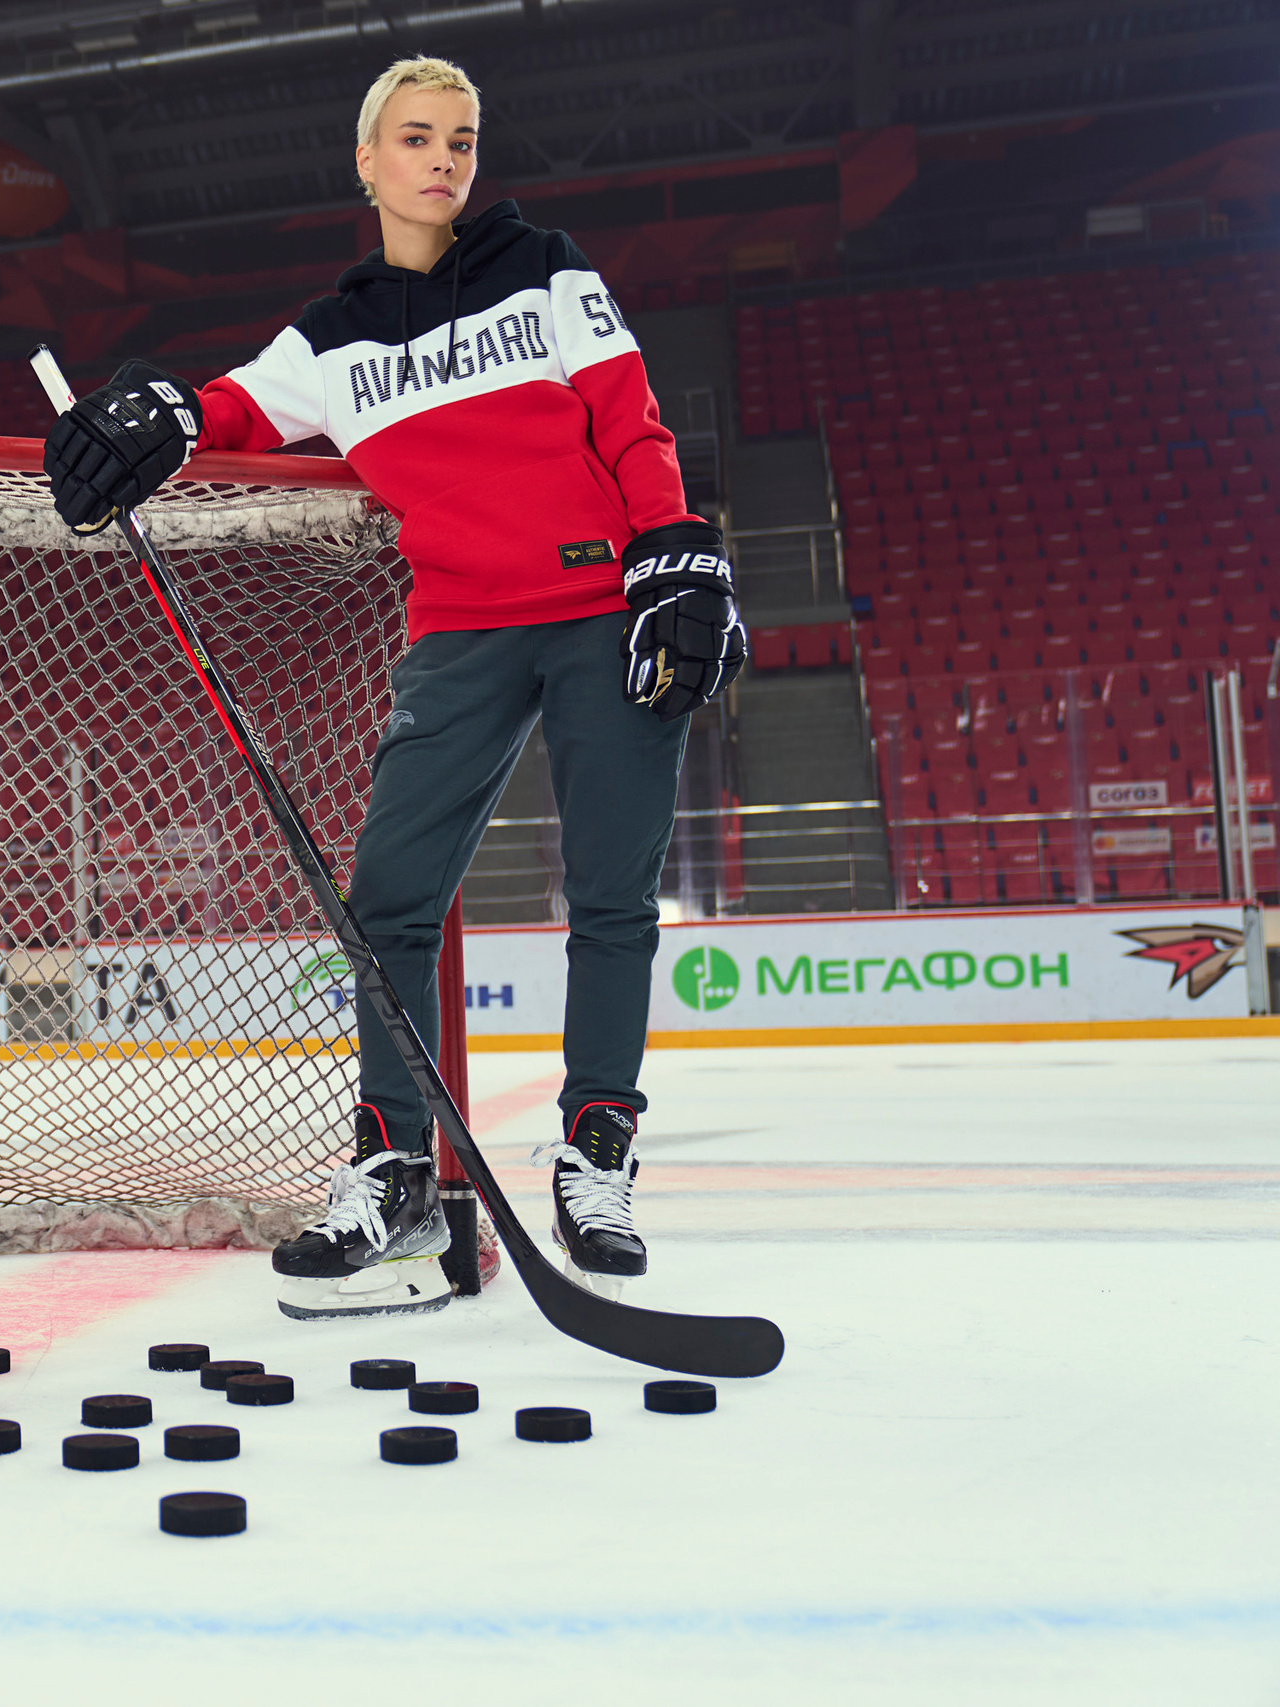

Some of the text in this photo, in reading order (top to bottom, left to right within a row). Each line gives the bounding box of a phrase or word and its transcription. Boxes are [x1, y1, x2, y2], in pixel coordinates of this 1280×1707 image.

[349, 311, 549, 414] AVANGARD
[623, 552, 733, 597] BAUER
[606, 1107, 634, 1130] VAPOR
[364, 1225, 401, 1259] BAER
